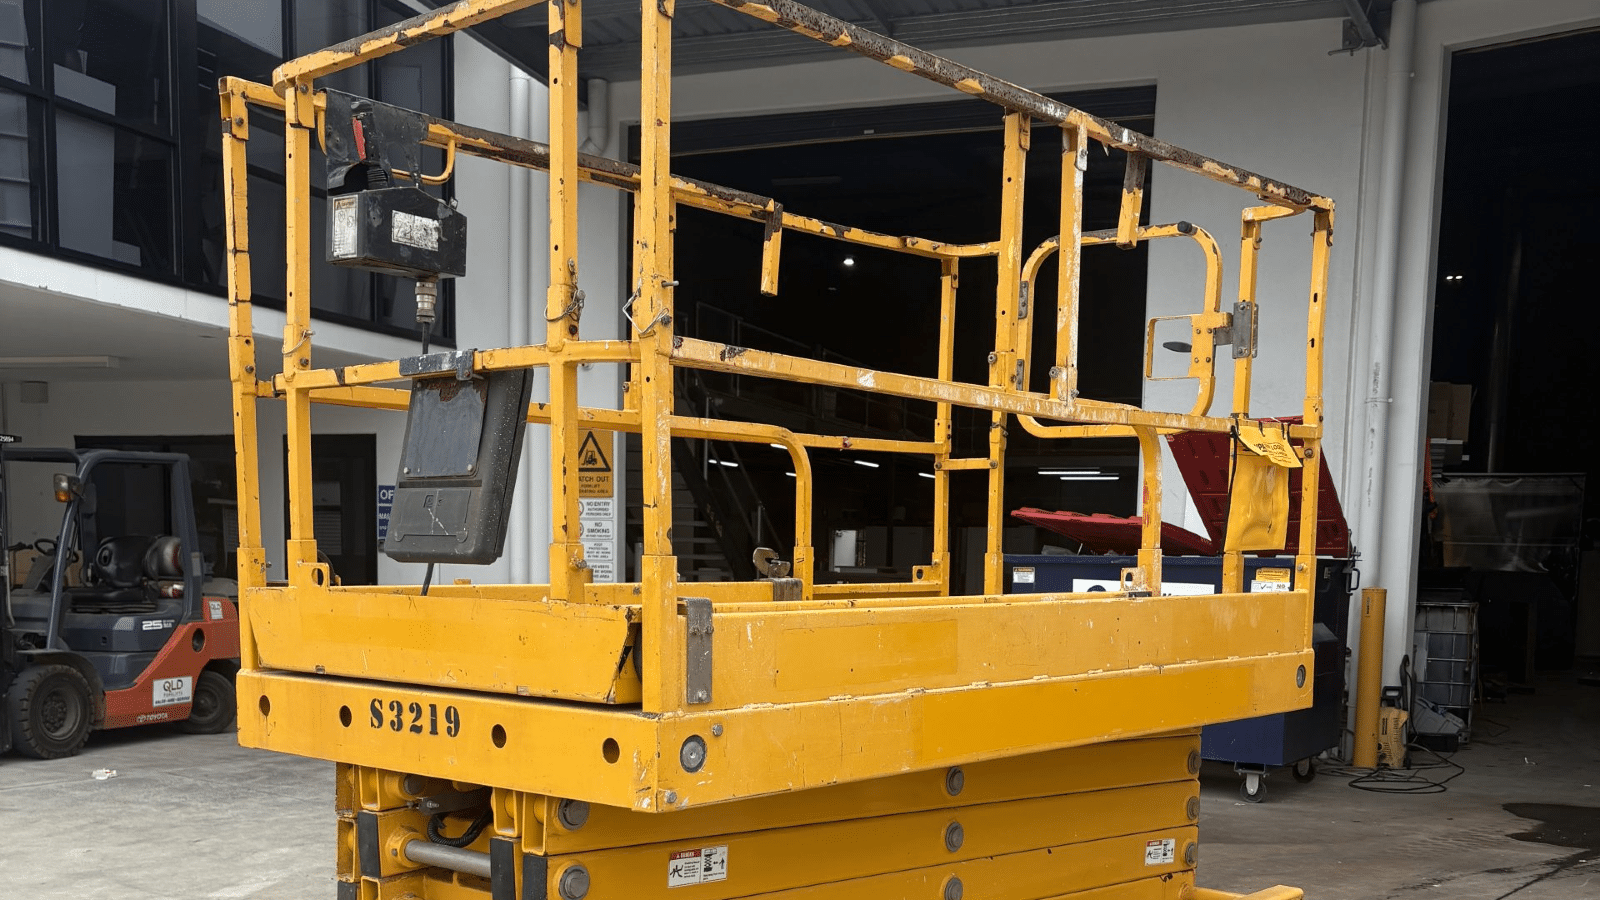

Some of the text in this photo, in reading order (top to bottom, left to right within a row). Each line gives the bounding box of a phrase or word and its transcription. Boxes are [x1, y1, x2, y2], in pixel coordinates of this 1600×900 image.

[380, 489, 394, 500] OF
[142, 619, 163, 631] 25
[163, 679, 183, 692] QLD
[370, 698, 460, 737] S3219
